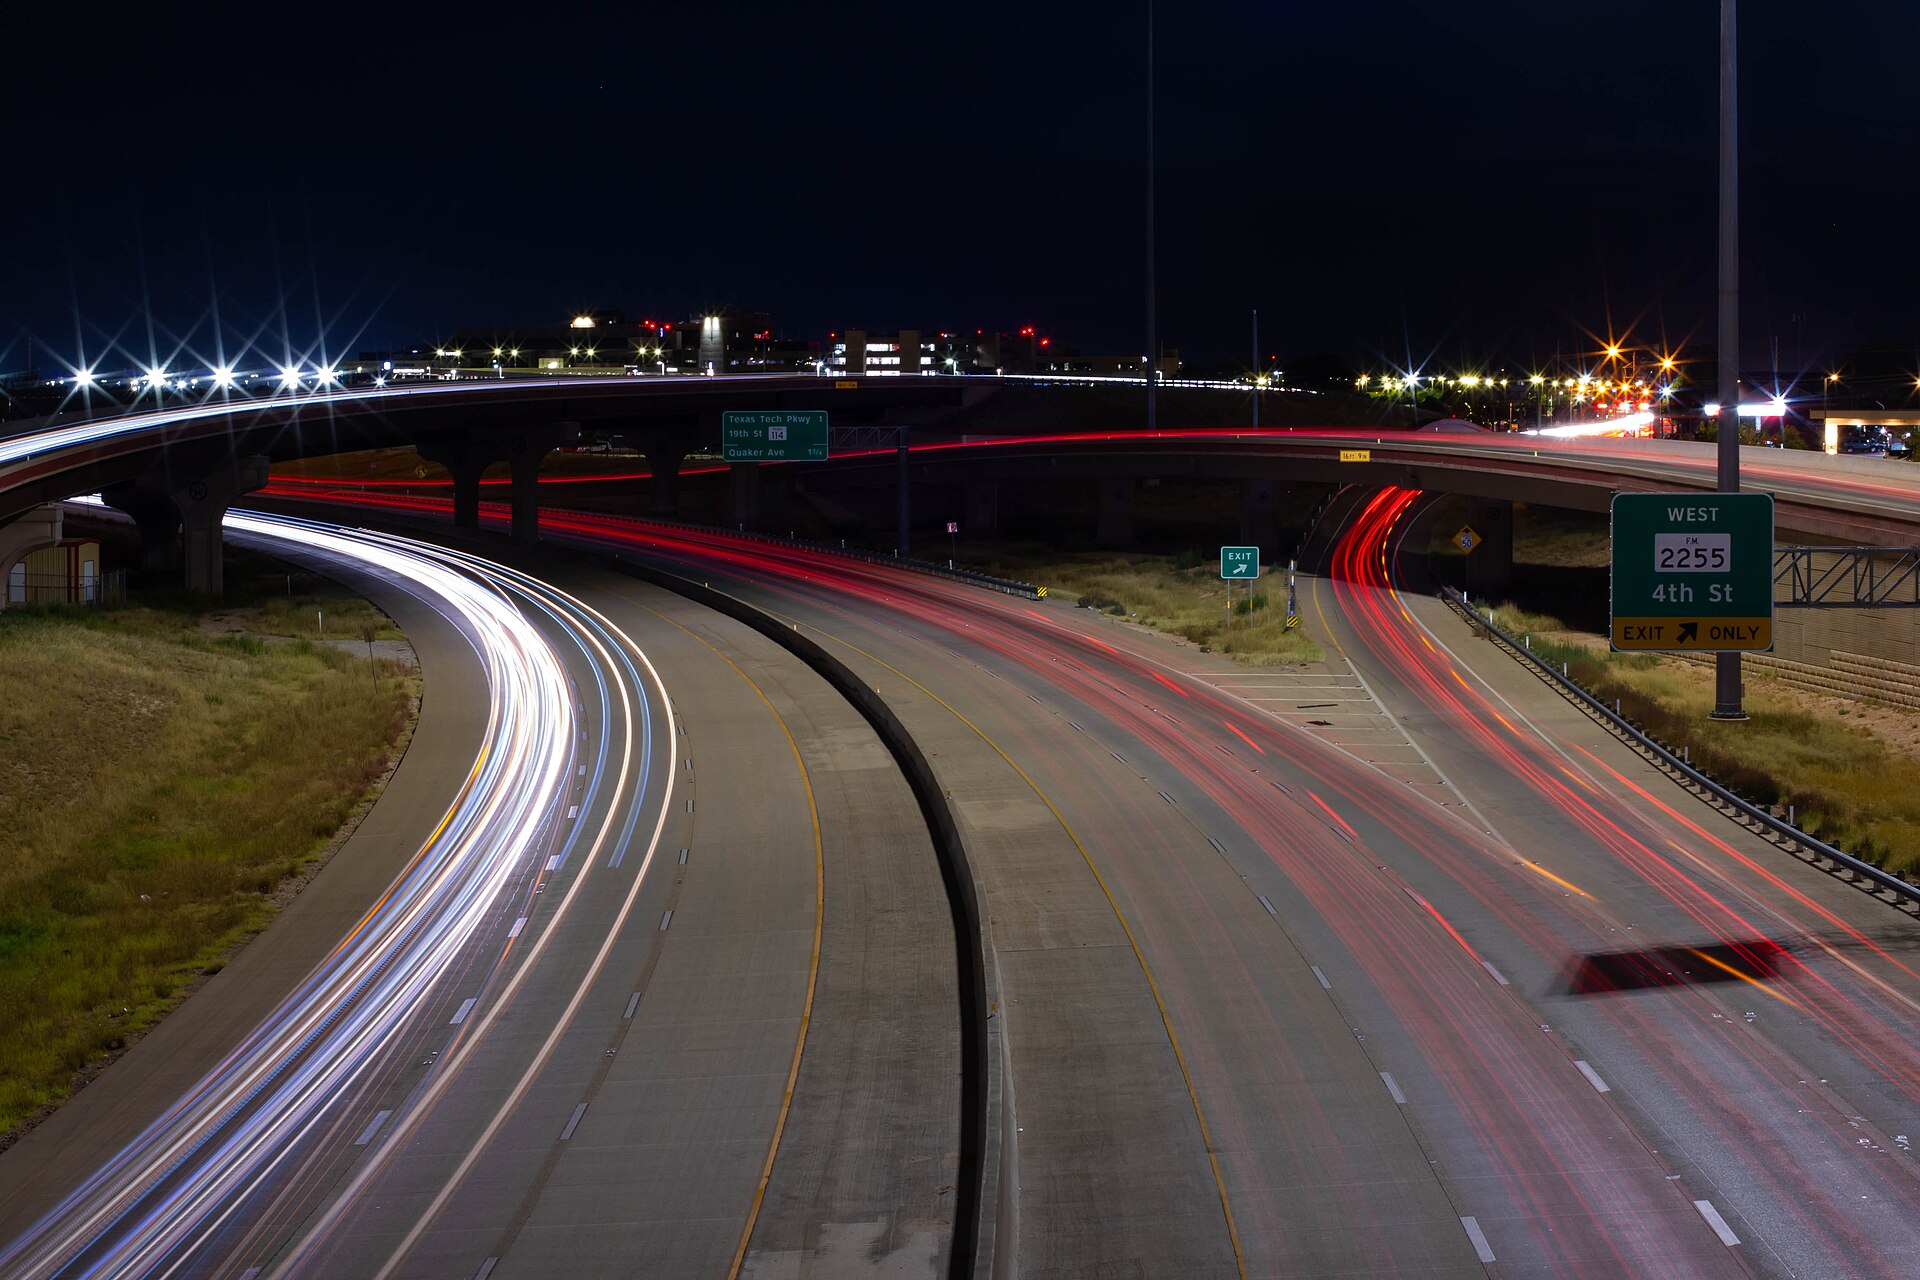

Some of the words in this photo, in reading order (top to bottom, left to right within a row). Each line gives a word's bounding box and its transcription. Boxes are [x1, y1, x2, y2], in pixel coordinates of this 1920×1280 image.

[729, 415, 756, 423] Texas
[760, 415, 782, 423] Tech
[787, 415, 811, 425] Pkwy
[819, 415, 823, 423] 1
[729, 430, 749, 438] 19th
[754, 430, 763, 438] St
[772, 431, 784, 439] 114
[729, 449, 763, 457] Quaker
[768, 449, 785, 457] Ave
[1667, 507, 1719, 522] WEST
[1462, 539, 1472, 547] 50
[1685, 537, 1699, 545] F.M.
[1228, 552, 1252, 560] EXIT
[1660, 548, 1725, 568] 2255
[1652, 583, 1693, 602] 4th
[1709, 583, 1733, 602] St
[1623, 626, 1664, 640] EXIT
[1710, 626, 1760, 640] ONLY
